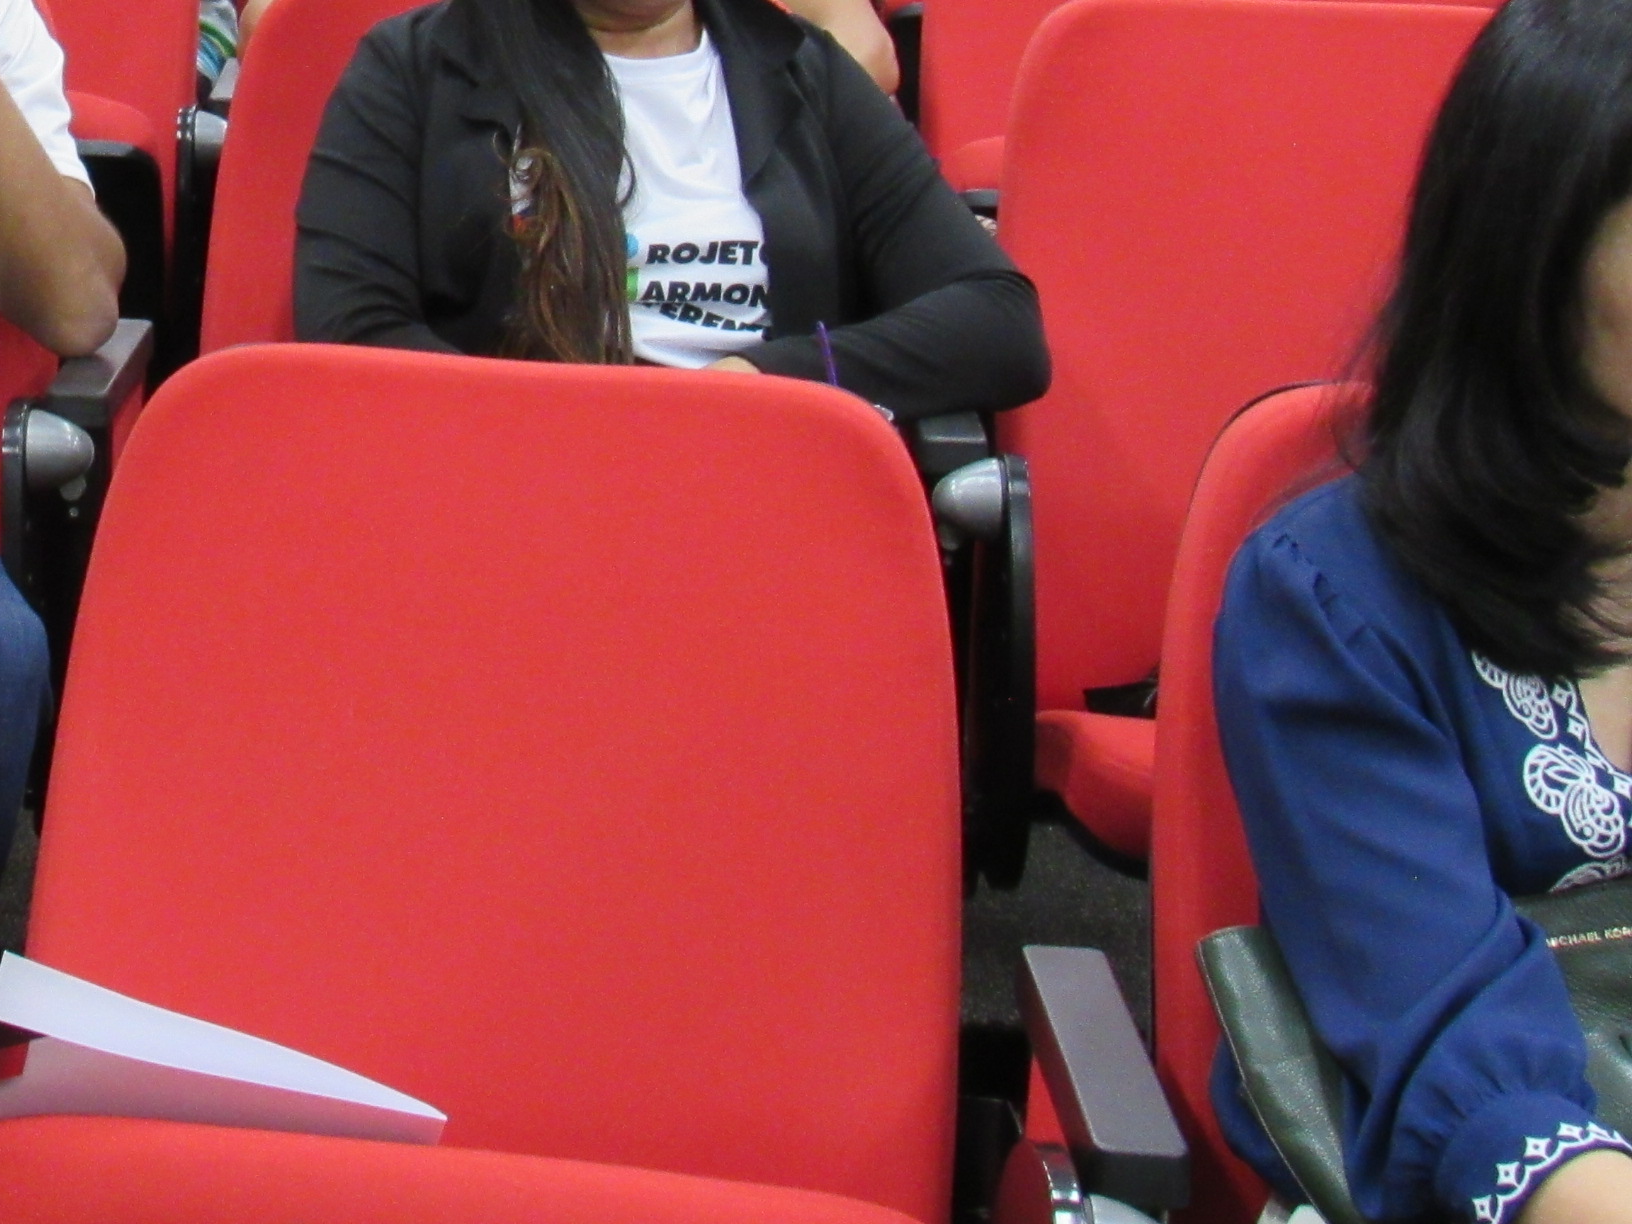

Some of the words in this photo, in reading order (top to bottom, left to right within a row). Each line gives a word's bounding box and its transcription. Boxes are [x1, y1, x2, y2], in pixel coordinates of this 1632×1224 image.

[626, 233, 765, 266] ROJET
[626, 267, 769, 308] ARMON
[1604, 925, 1632, 940] KOR
